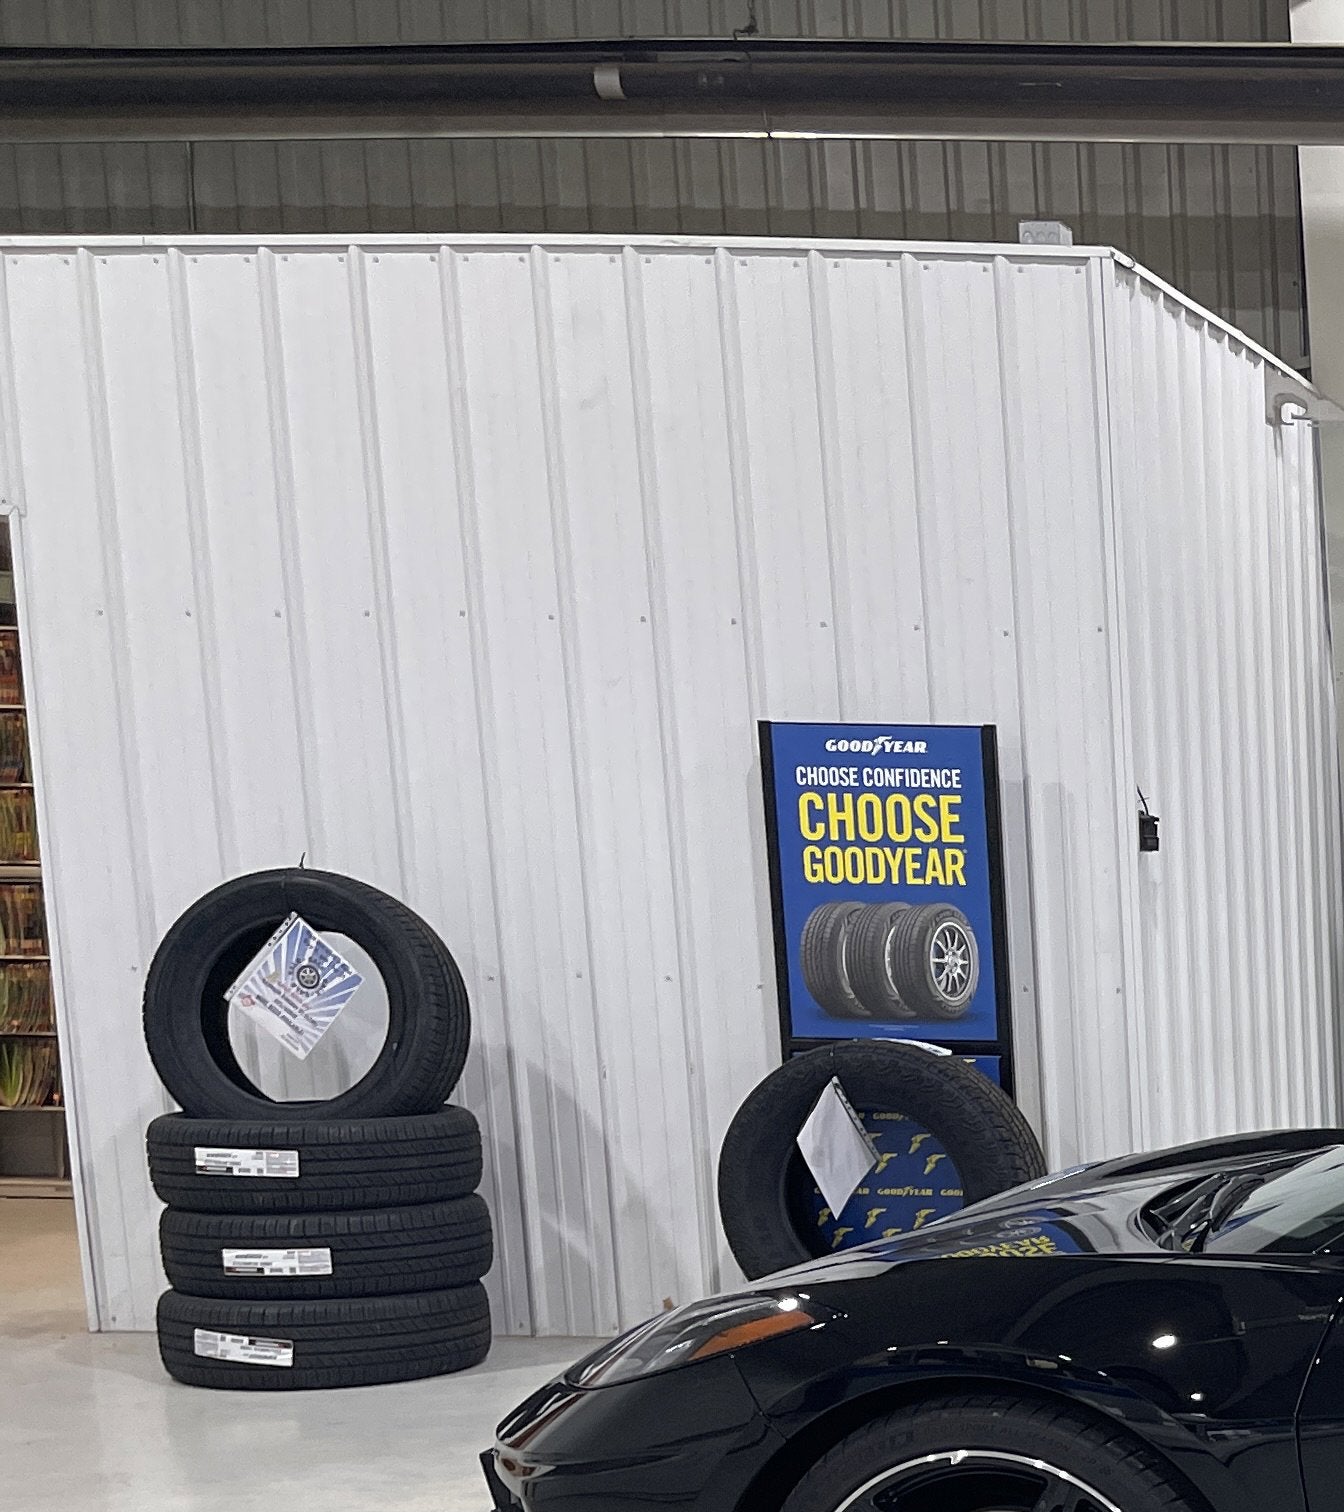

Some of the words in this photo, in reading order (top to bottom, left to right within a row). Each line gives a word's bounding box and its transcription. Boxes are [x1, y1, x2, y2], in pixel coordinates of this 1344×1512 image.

[825, 736, 928, 756] GOODYEAR
[796, 766, 859, 787] CHOOSE
[863, 768, 962, 788] CONFIDENCE
[798, 791, 965, 843] CHOOSE
[803, 845, 966, 886] GOODYEAR
[877, 1186, 933, 1197] GOODYEAR
